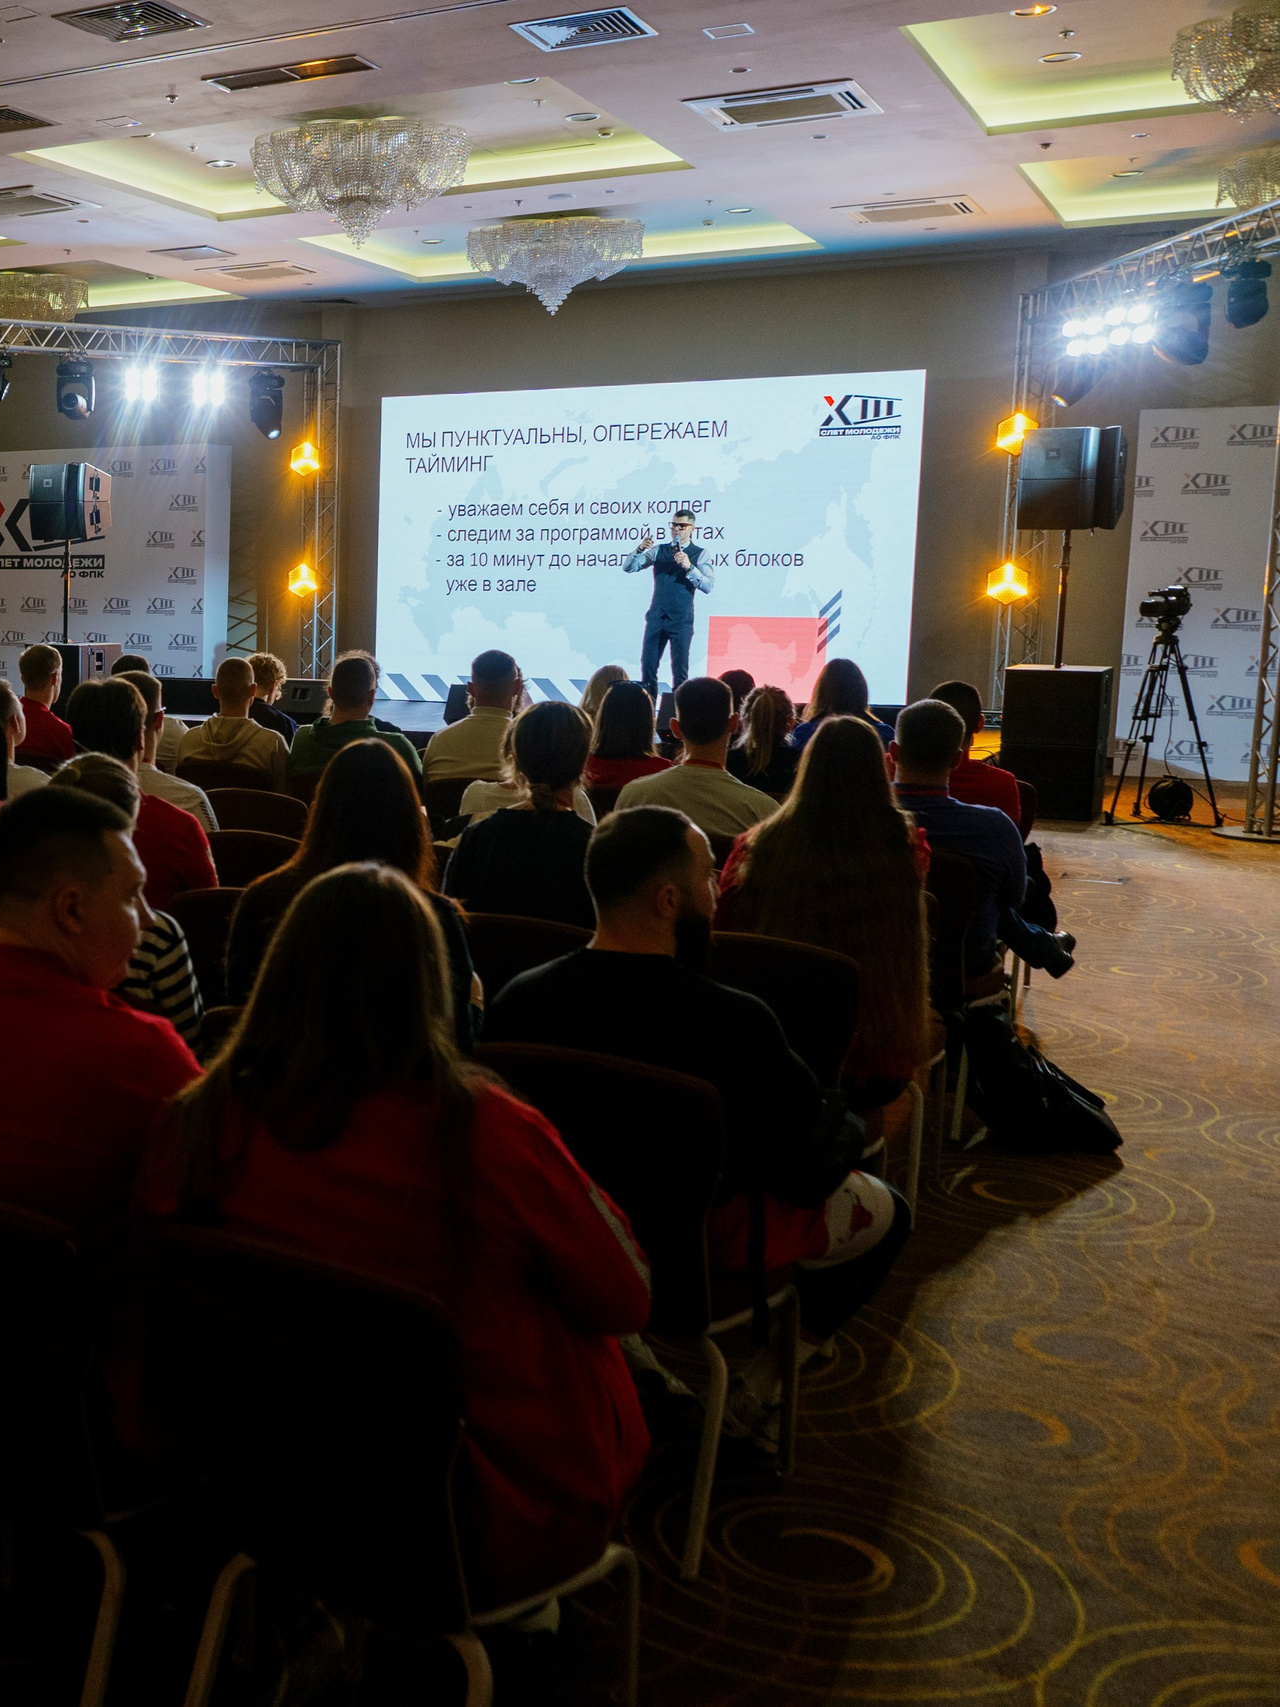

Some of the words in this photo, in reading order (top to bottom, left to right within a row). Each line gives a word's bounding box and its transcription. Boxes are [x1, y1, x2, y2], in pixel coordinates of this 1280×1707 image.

[406, 431, 437, 449] МЫ
[441, 425, 588, 448] ПУНКТУАЛЬНЫ,
[593, 420, 728, 443] ОПЕРЕЖАЕМ
[845, 427, 900, 436] МОЛОДЕЖИ
[405, 453, 494, 474] ТАЙМИНГ
[448, 502, 523, 521] уважаем
[528, 498, 569, 516] себя
[574, 502, 585, 515] и
[589, 501, 642, 515] своих
[447, 528, 511, 545] следим
[516, 528, 535, 542] за
[540, 523, 651, 545] программой
[656, 527, 666, 540] в
[446, 553, 465, 567] за
[470, 552, 488, 567] 10
[493, 553, 545, 571] минут
[548, 553, 571, 569] до
[735, 549, 804, 567] блоков
[78, 570, 105, 578] ФПК
[446, 578, 477, 595] уже
[482, 579, 491, 592] в
[496, 578, 537, 592] зале
